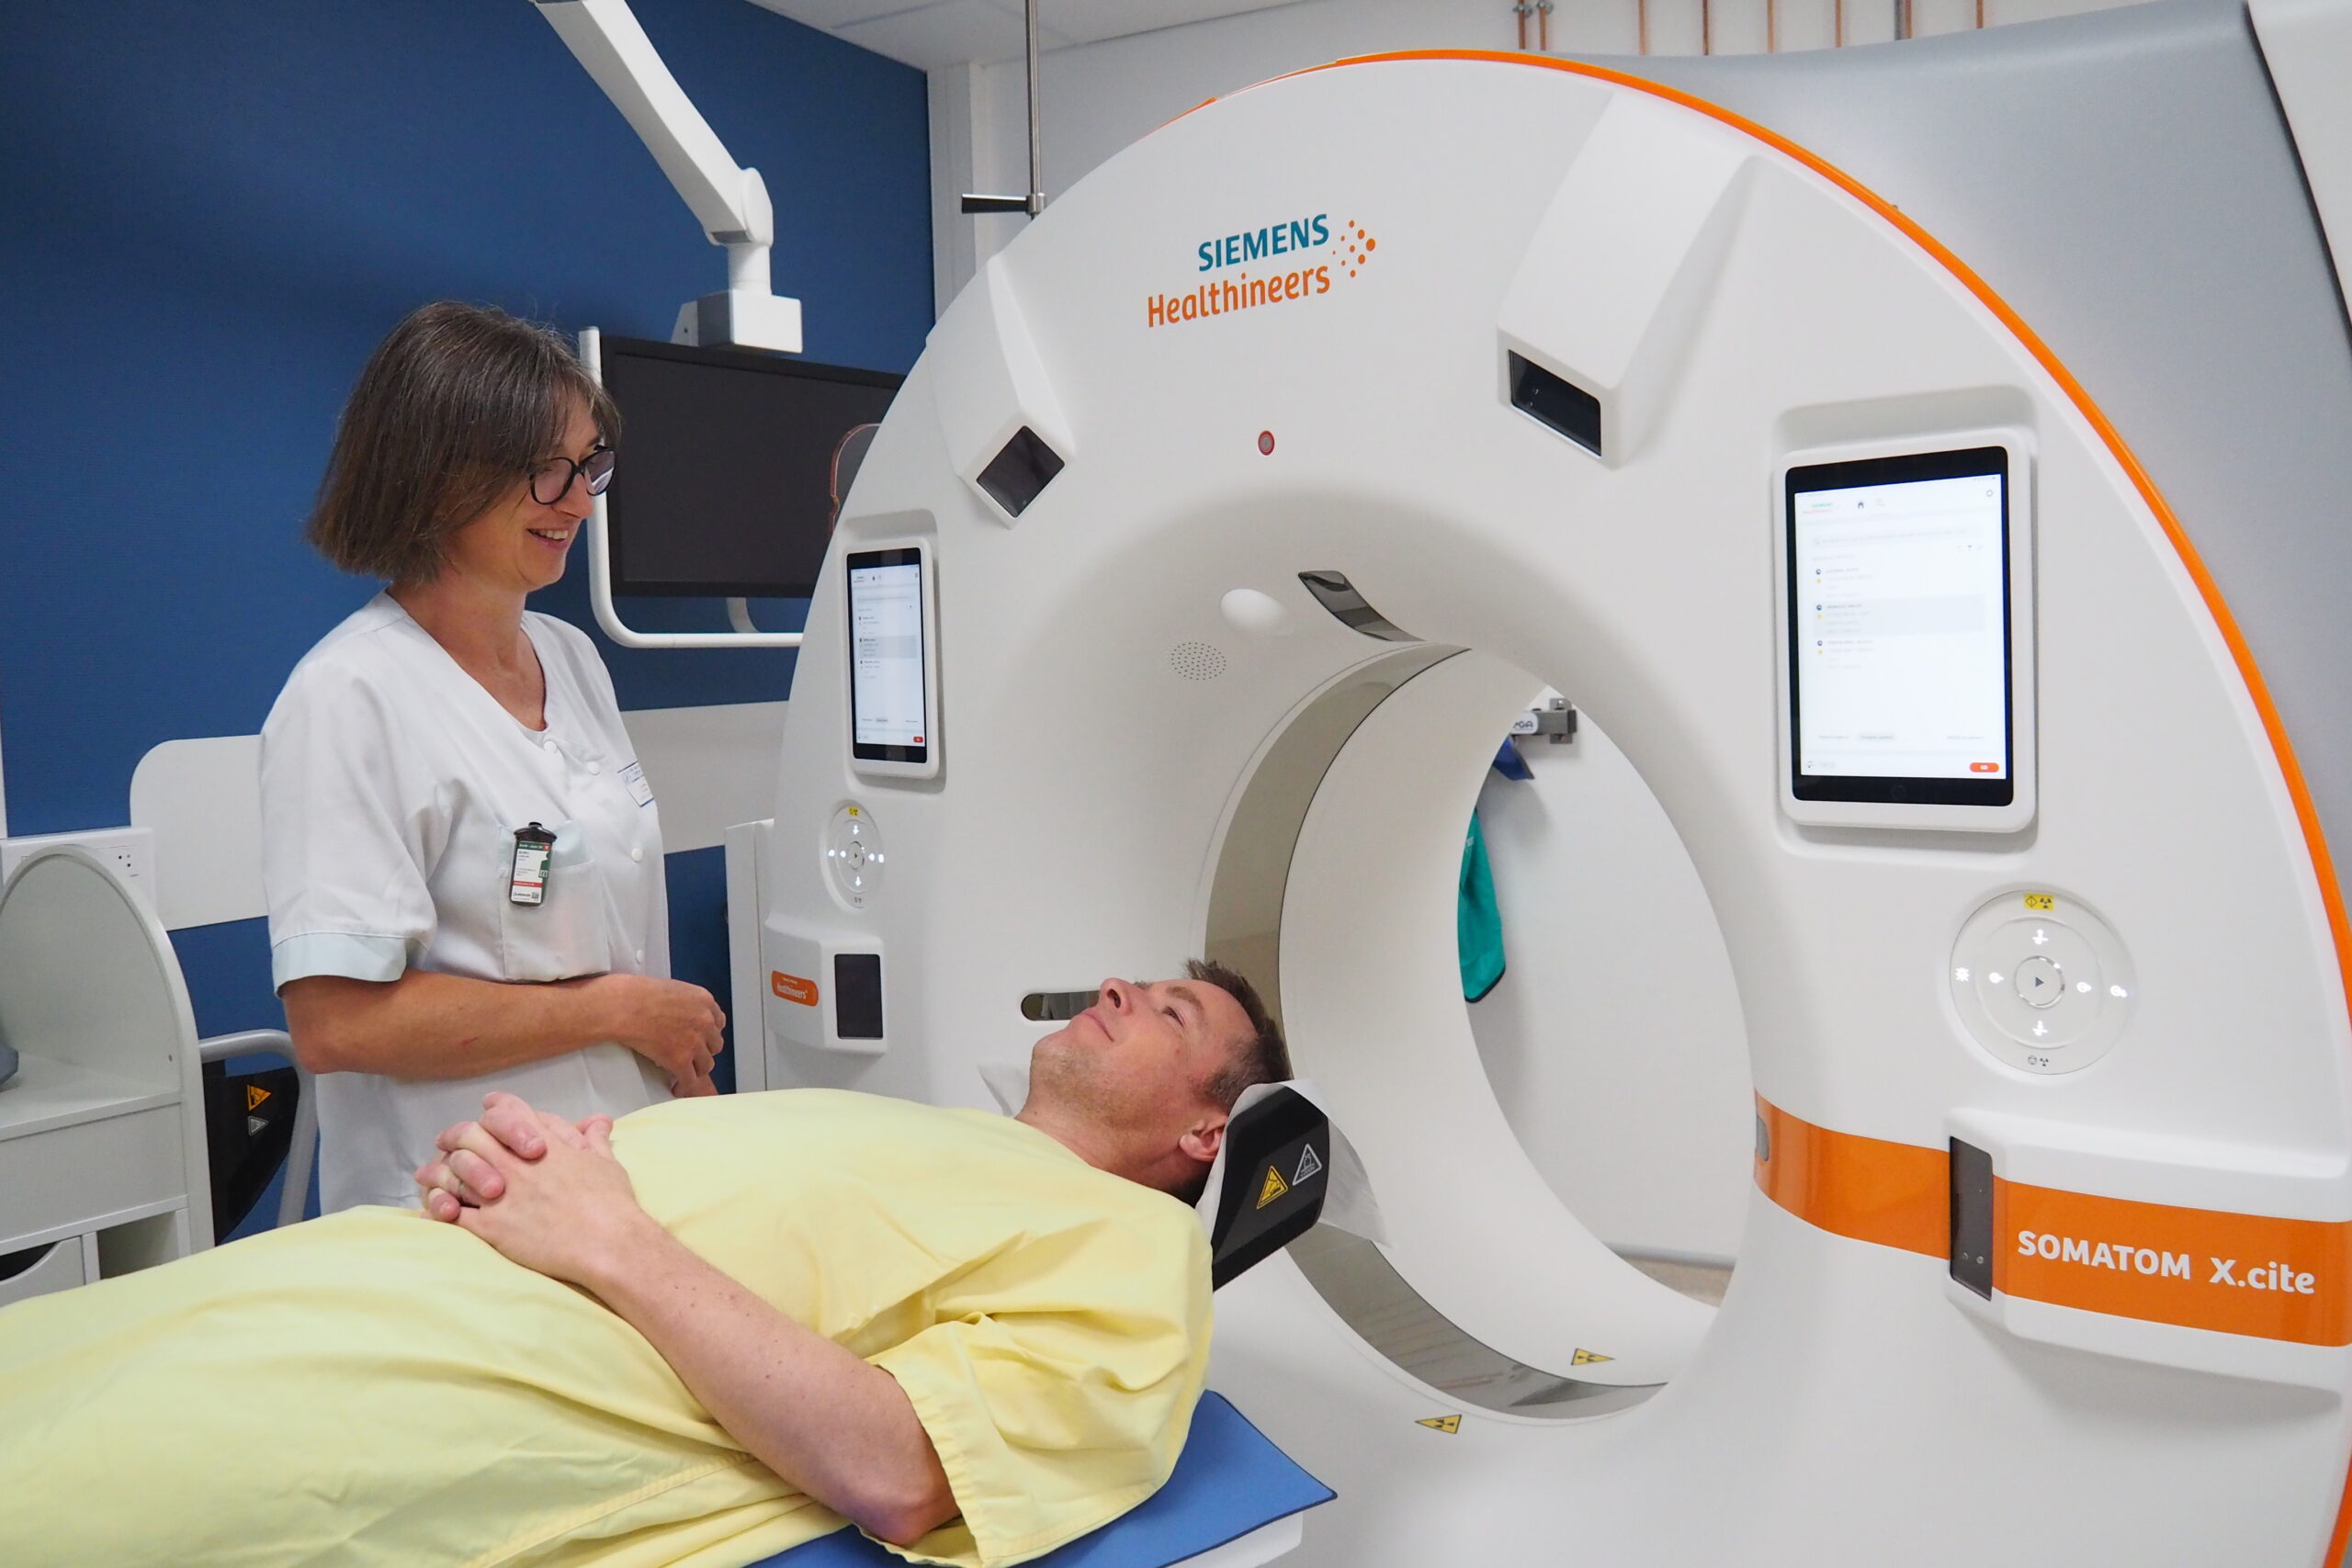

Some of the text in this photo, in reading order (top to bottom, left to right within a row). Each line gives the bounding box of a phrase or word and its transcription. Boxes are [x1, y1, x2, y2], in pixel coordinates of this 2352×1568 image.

[1198, 214, 1329, 272] SIEMENS
[1148, 265, 1330, 328] Healthineers
[2018, 1230, 2315, 1294] SOMATOM X.cite
